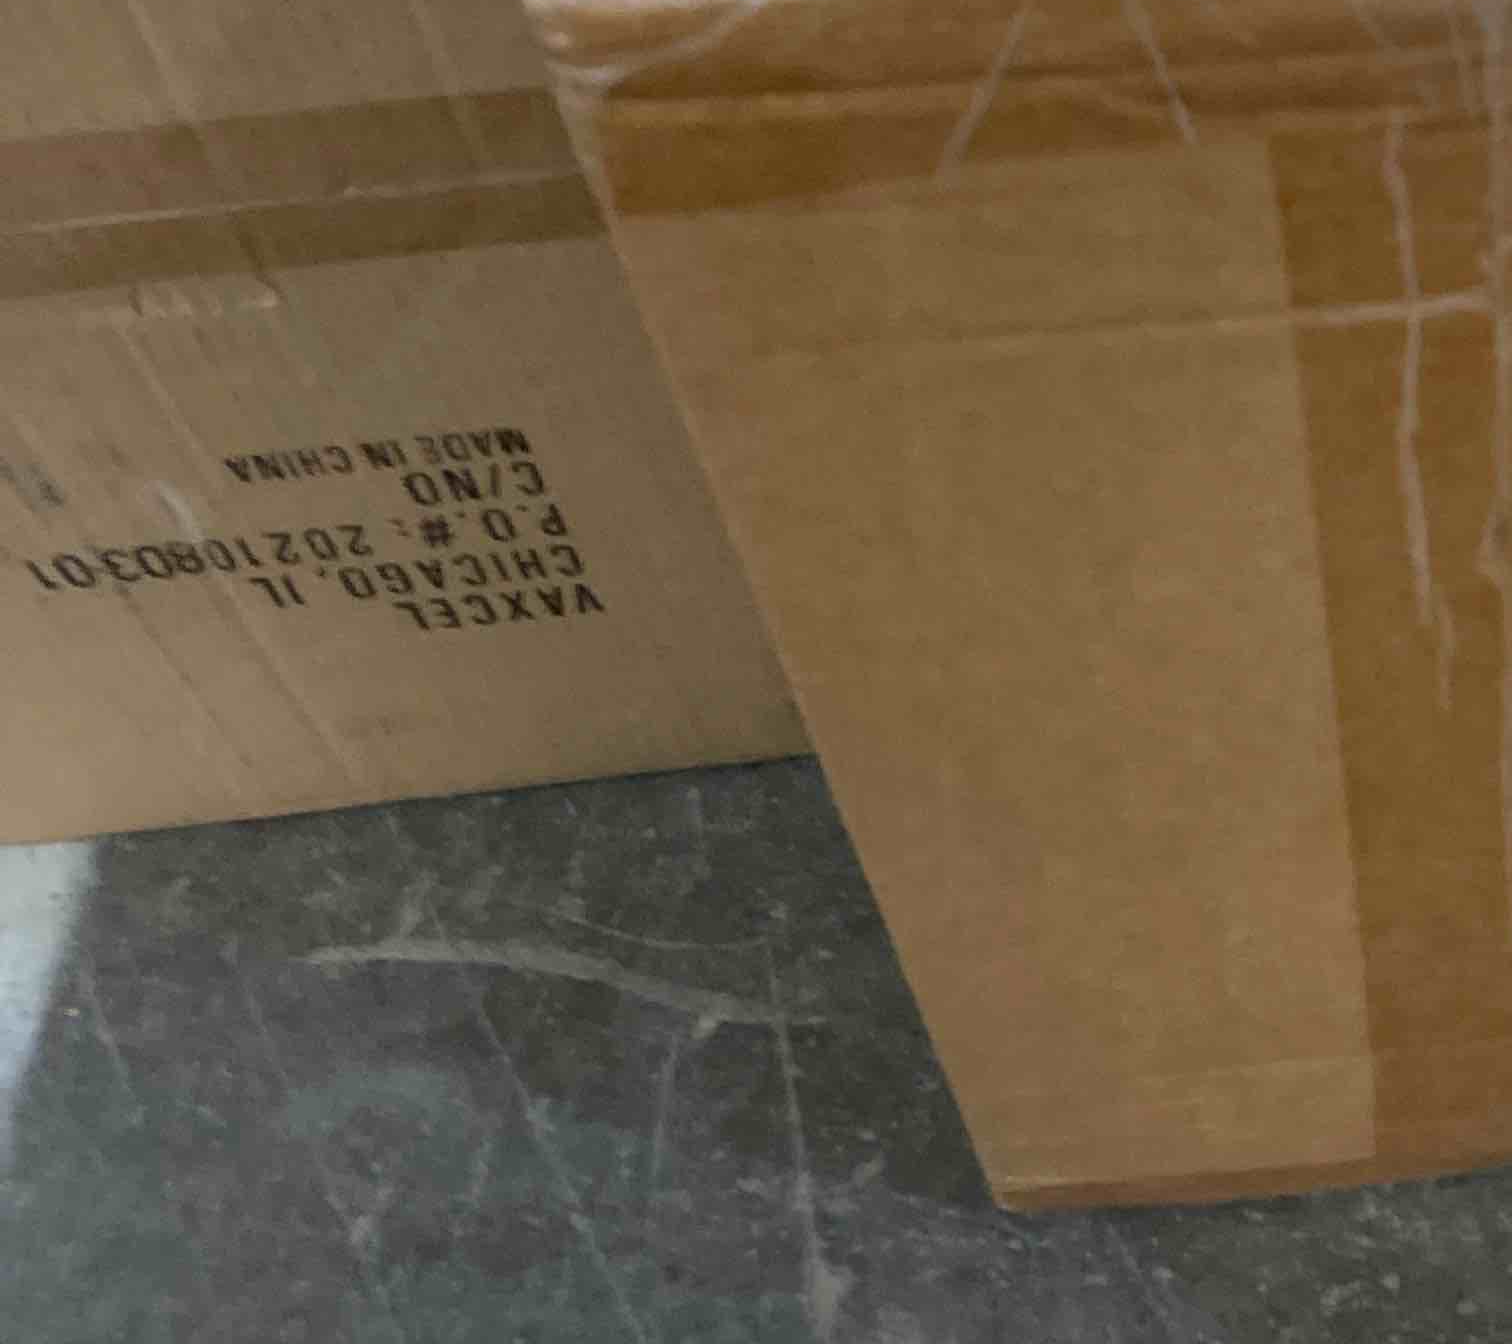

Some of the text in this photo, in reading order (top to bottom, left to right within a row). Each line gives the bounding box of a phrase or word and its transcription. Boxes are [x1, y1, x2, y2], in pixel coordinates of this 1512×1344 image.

[223, 426, 531, 484] MADE IN CHINA
[250, 574, 305, 610] IL
[395, 582, 605, 631] VAXCEL
